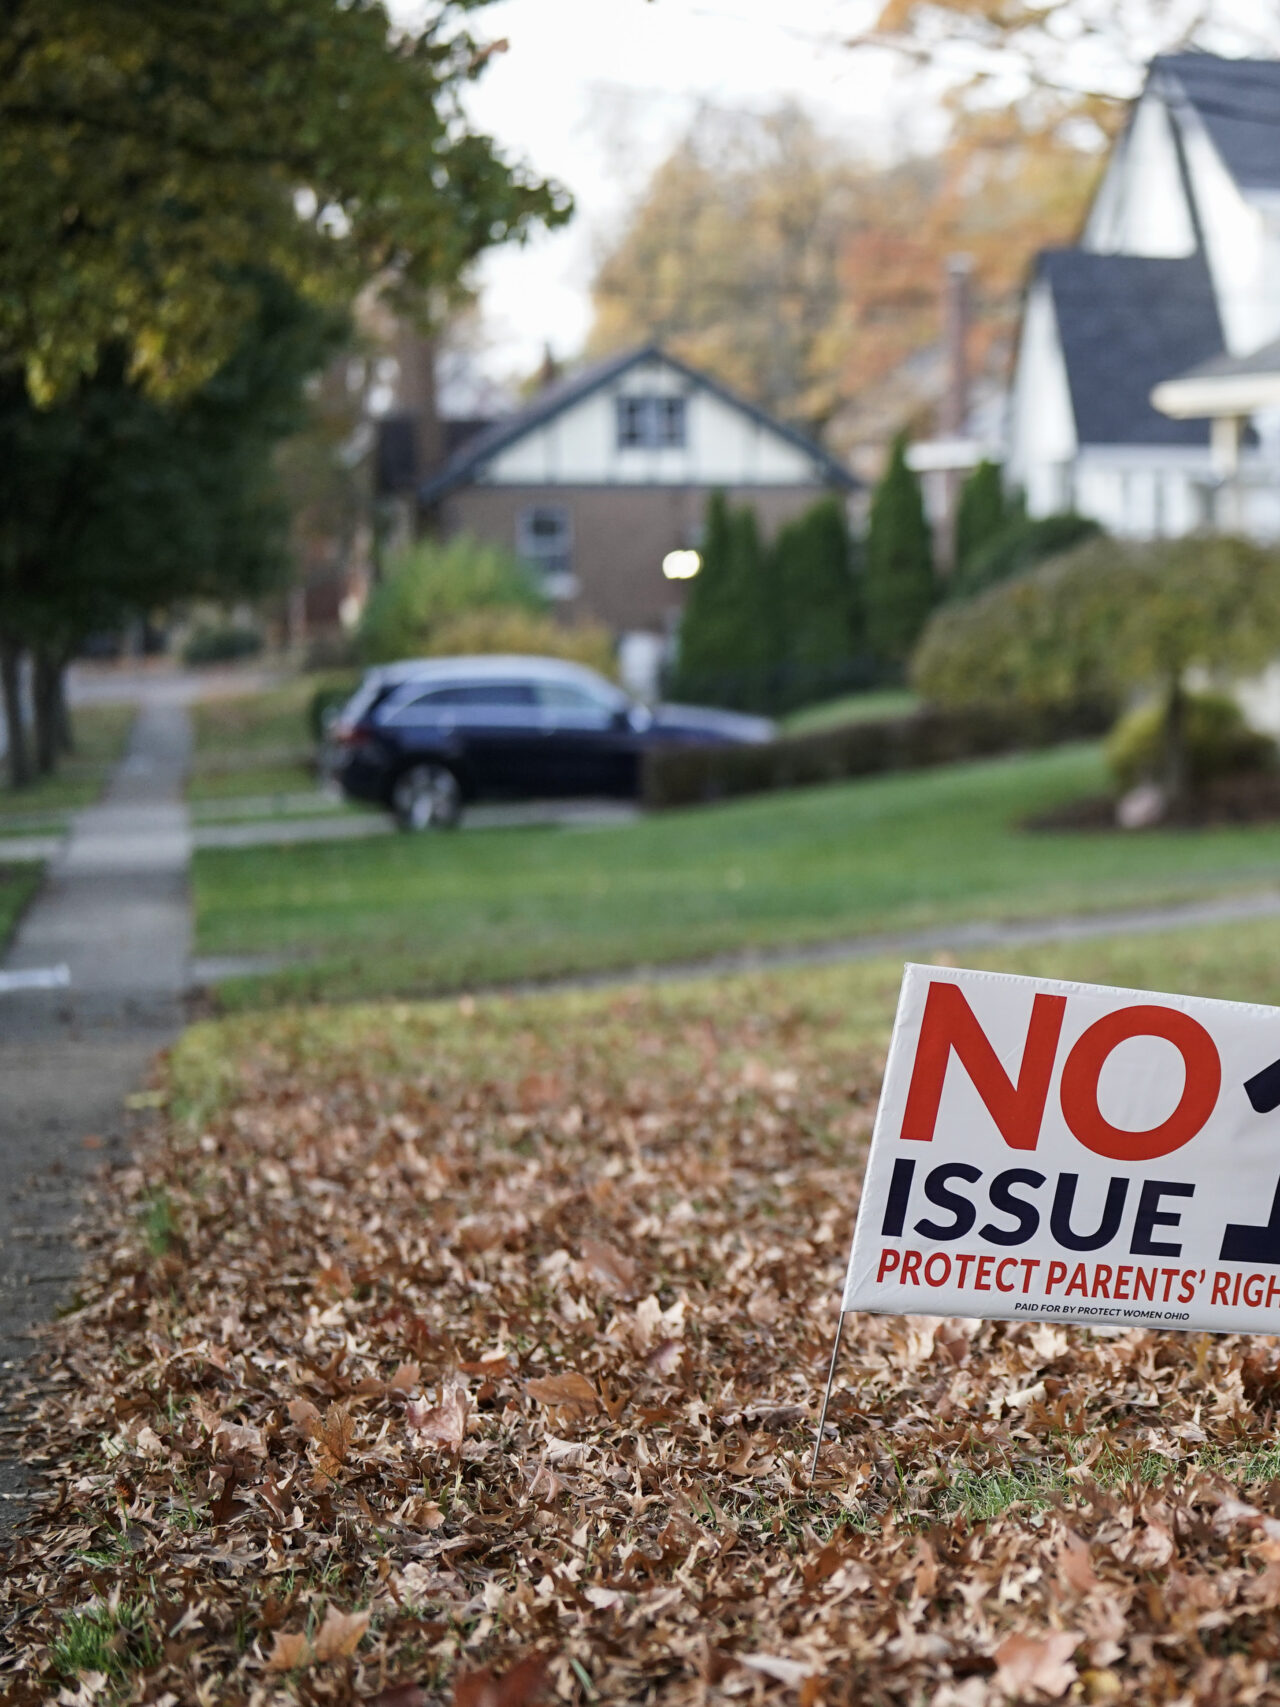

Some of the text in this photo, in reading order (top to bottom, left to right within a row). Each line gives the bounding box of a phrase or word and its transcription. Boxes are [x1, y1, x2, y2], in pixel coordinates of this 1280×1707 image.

[900, 981, 1222, 1161] NO
[881, 1158, 1196, 1258] ISSUE
[876, 1248, 1040, 1294] PROTECT
[1045, 1260, 1206, 1304] PARENTS'
[1014, 1302, 1190, 1321] PAID FOR BY PROTECT WOMEN OHIO
